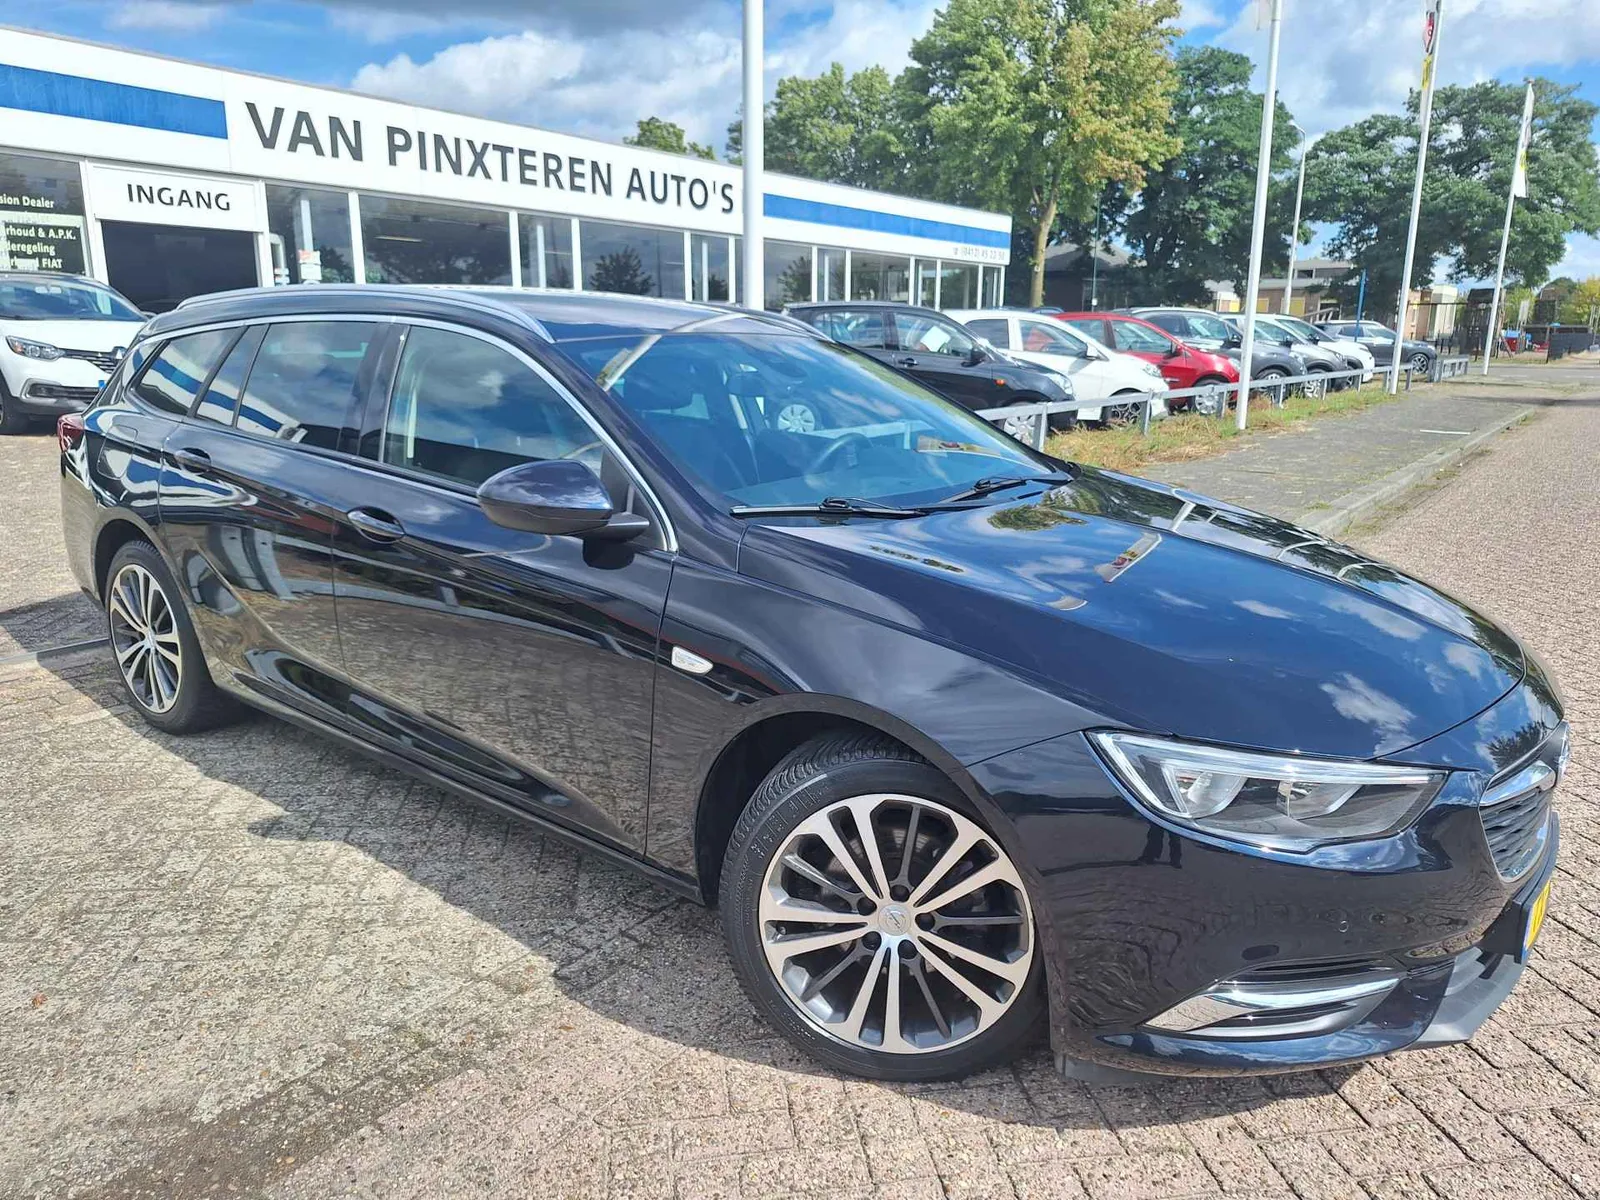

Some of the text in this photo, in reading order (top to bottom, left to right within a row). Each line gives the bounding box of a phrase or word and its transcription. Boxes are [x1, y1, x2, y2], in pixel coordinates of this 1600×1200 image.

[245, 101, 734, 213] VAN PINXTEREN AUTO'S
[22, 196, 55, 209] Dealer
[127, 183, 231, 212] INGANG
[38, 228, 45, 237] &
[48, 229, 76, 240] A.P.K.
[42, 257, 63, 269] FIAT
